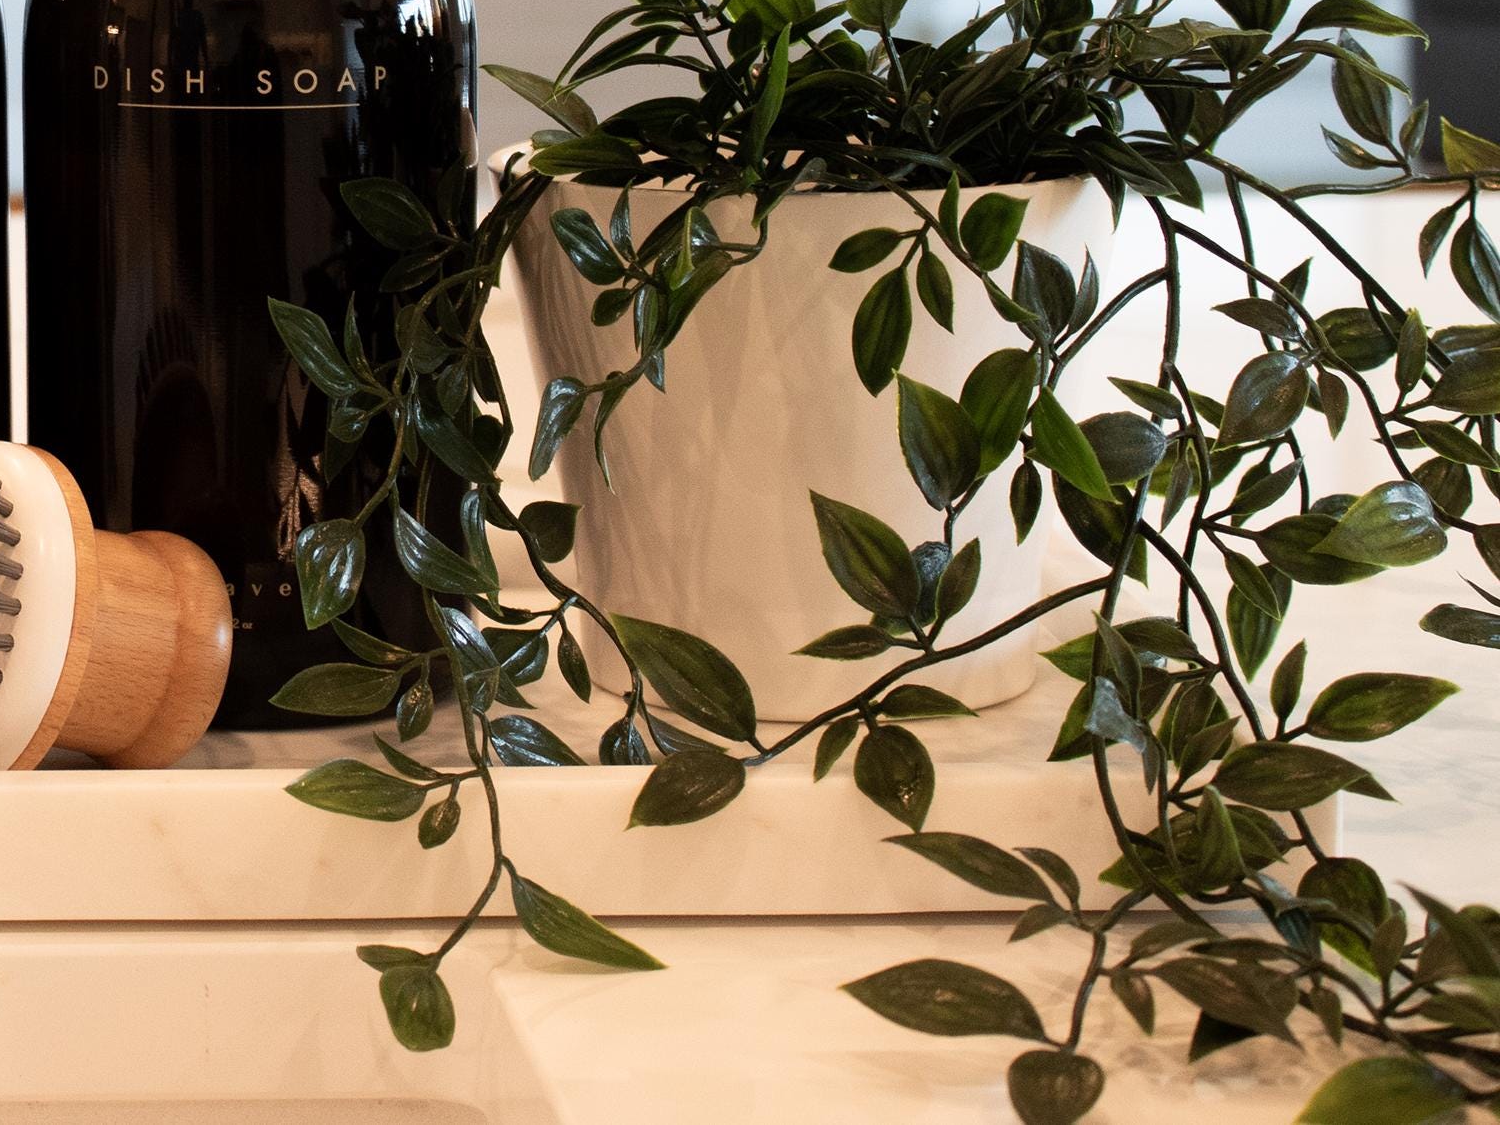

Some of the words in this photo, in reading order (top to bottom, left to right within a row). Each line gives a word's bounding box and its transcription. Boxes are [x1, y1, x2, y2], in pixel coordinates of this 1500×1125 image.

[93, 65, 205, 95] DISH
[256, 65, 388, 95] SOAP
[226, 582, 292, 596] ave
